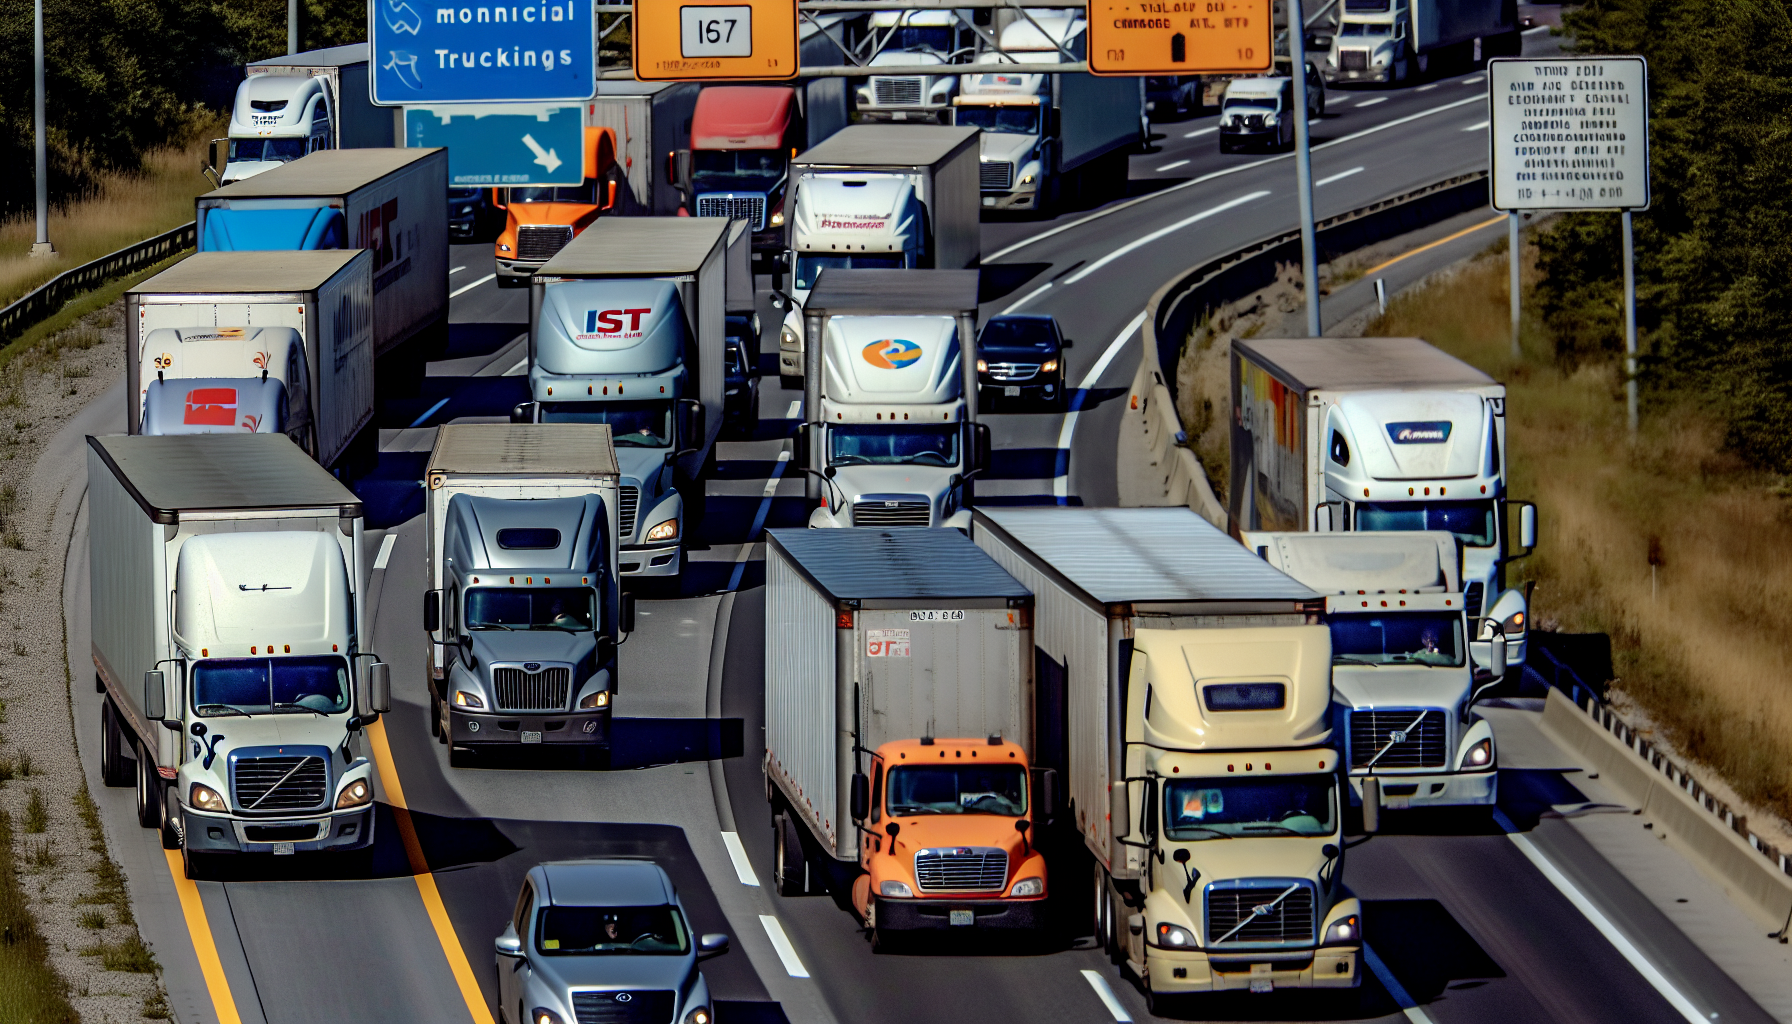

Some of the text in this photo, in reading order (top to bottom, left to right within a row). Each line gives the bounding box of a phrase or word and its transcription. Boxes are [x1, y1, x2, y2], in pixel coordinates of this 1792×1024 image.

[698, 19, 738, 44] 167
[434, 46, 572, 71] Truckings
[585, 307, 652, 334] IST
